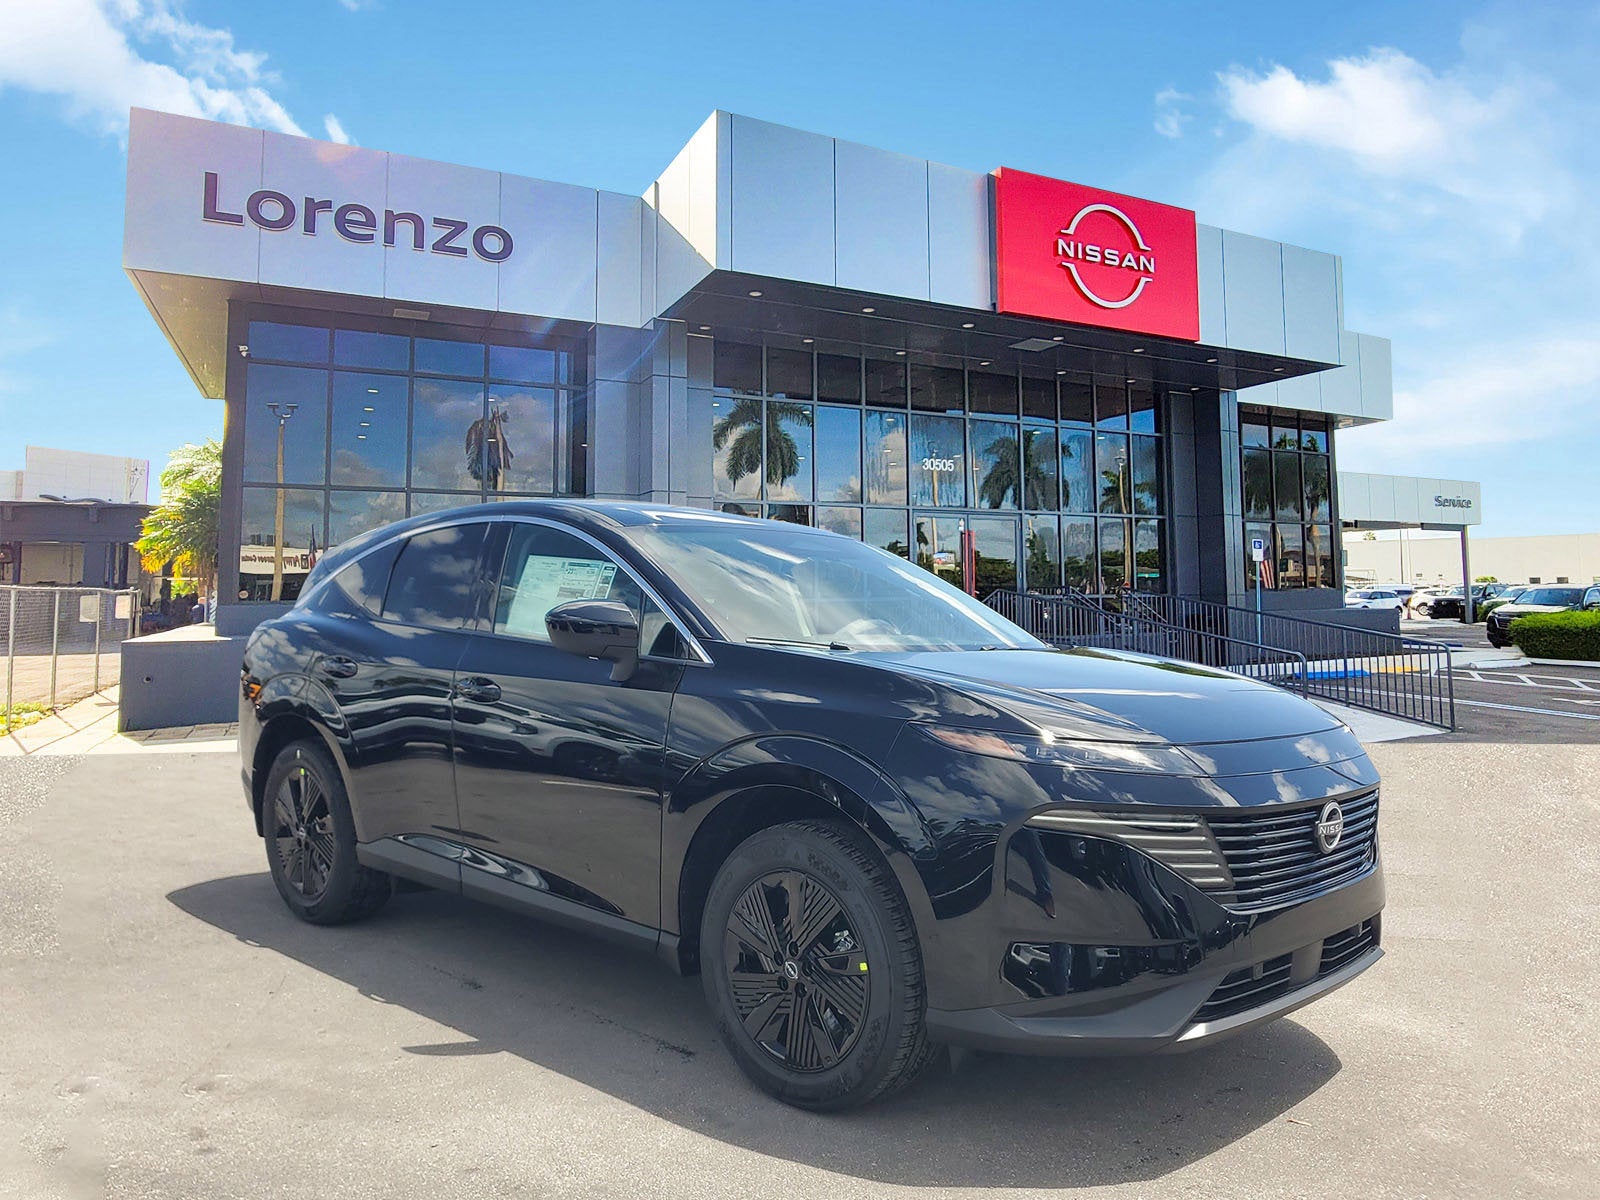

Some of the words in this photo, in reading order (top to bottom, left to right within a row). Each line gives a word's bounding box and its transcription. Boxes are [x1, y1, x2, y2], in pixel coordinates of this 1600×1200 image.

[202, 170, 515, 263] Lorenzo
[1057, 237, 1155, 273] NISSAN
[922, 458, 955, 472] 30505
[1434, 495, 1472, 509] Service
[1319, 823, 1342, 835] NISS
